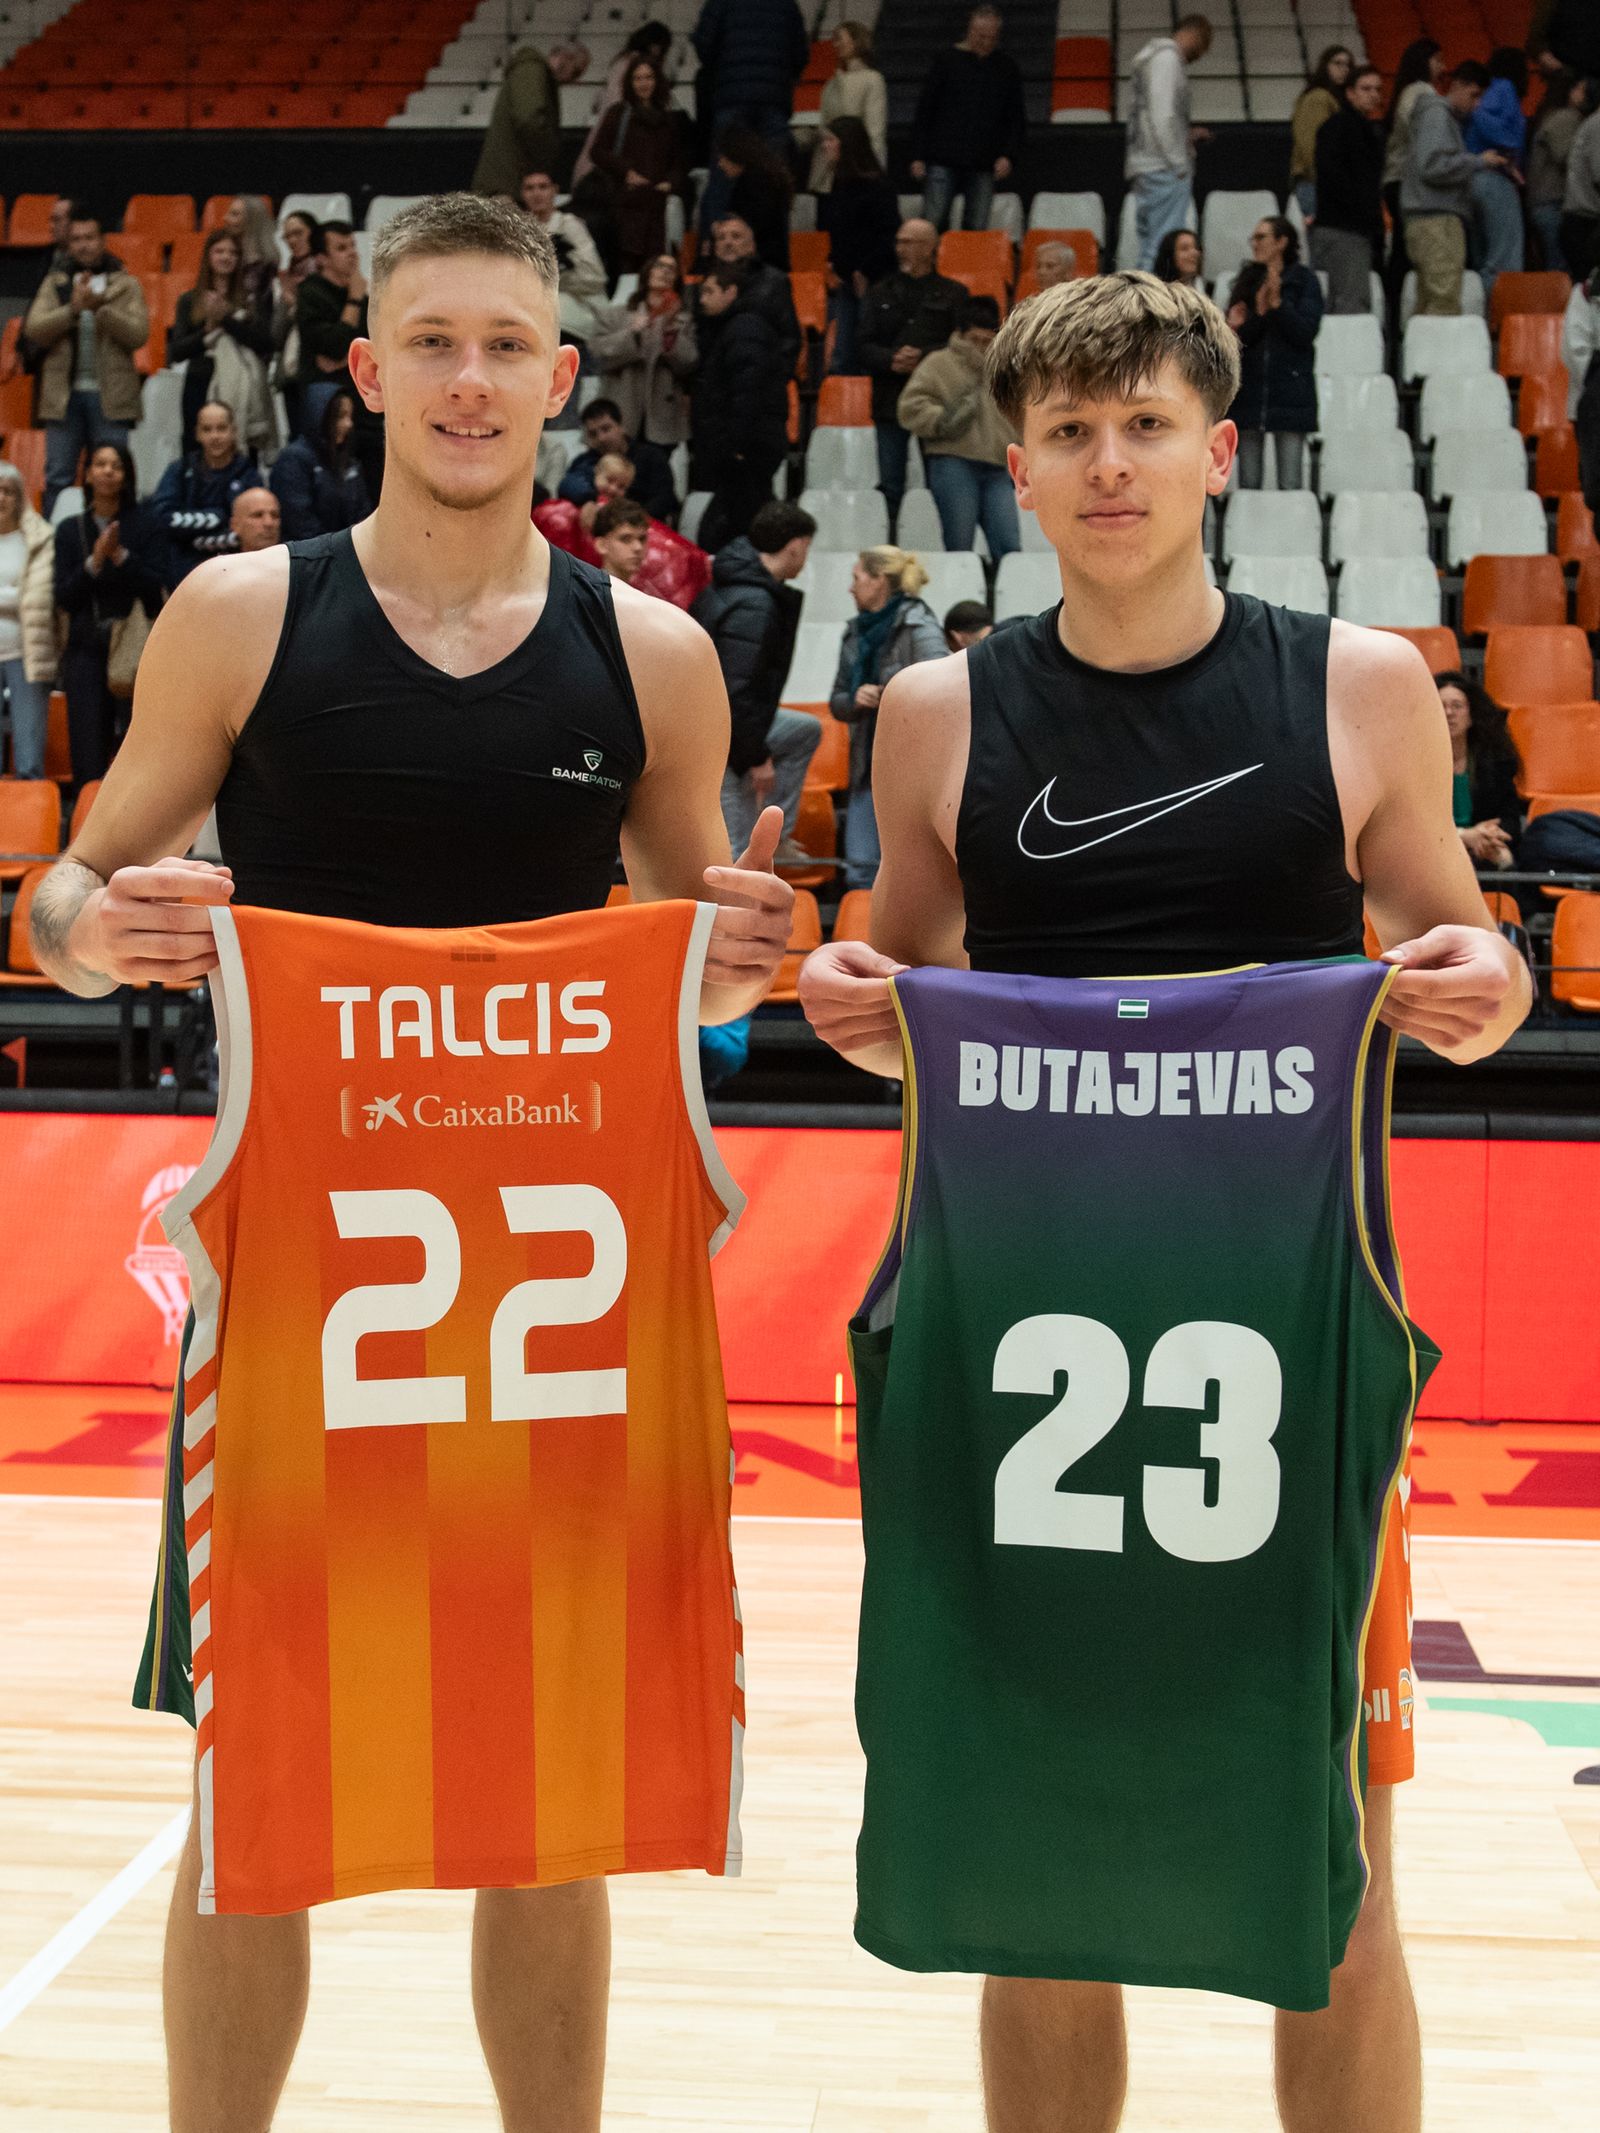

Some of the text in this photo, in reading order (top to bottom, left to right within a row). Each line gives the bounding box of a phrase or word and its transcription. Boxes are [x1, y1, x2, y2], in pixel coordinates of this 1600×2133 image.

[552, 767, 622, 790] GAMEPATCH
[321, 981, 611, 1059] TALCIS
[414, 1094, 580, 1127] CaixaBank
[959, 1041, 1315, 1116] BUTAJEVAS
[322, 1184, 627, 1430] 22
[992, 1314, 1282, 1562] 23
